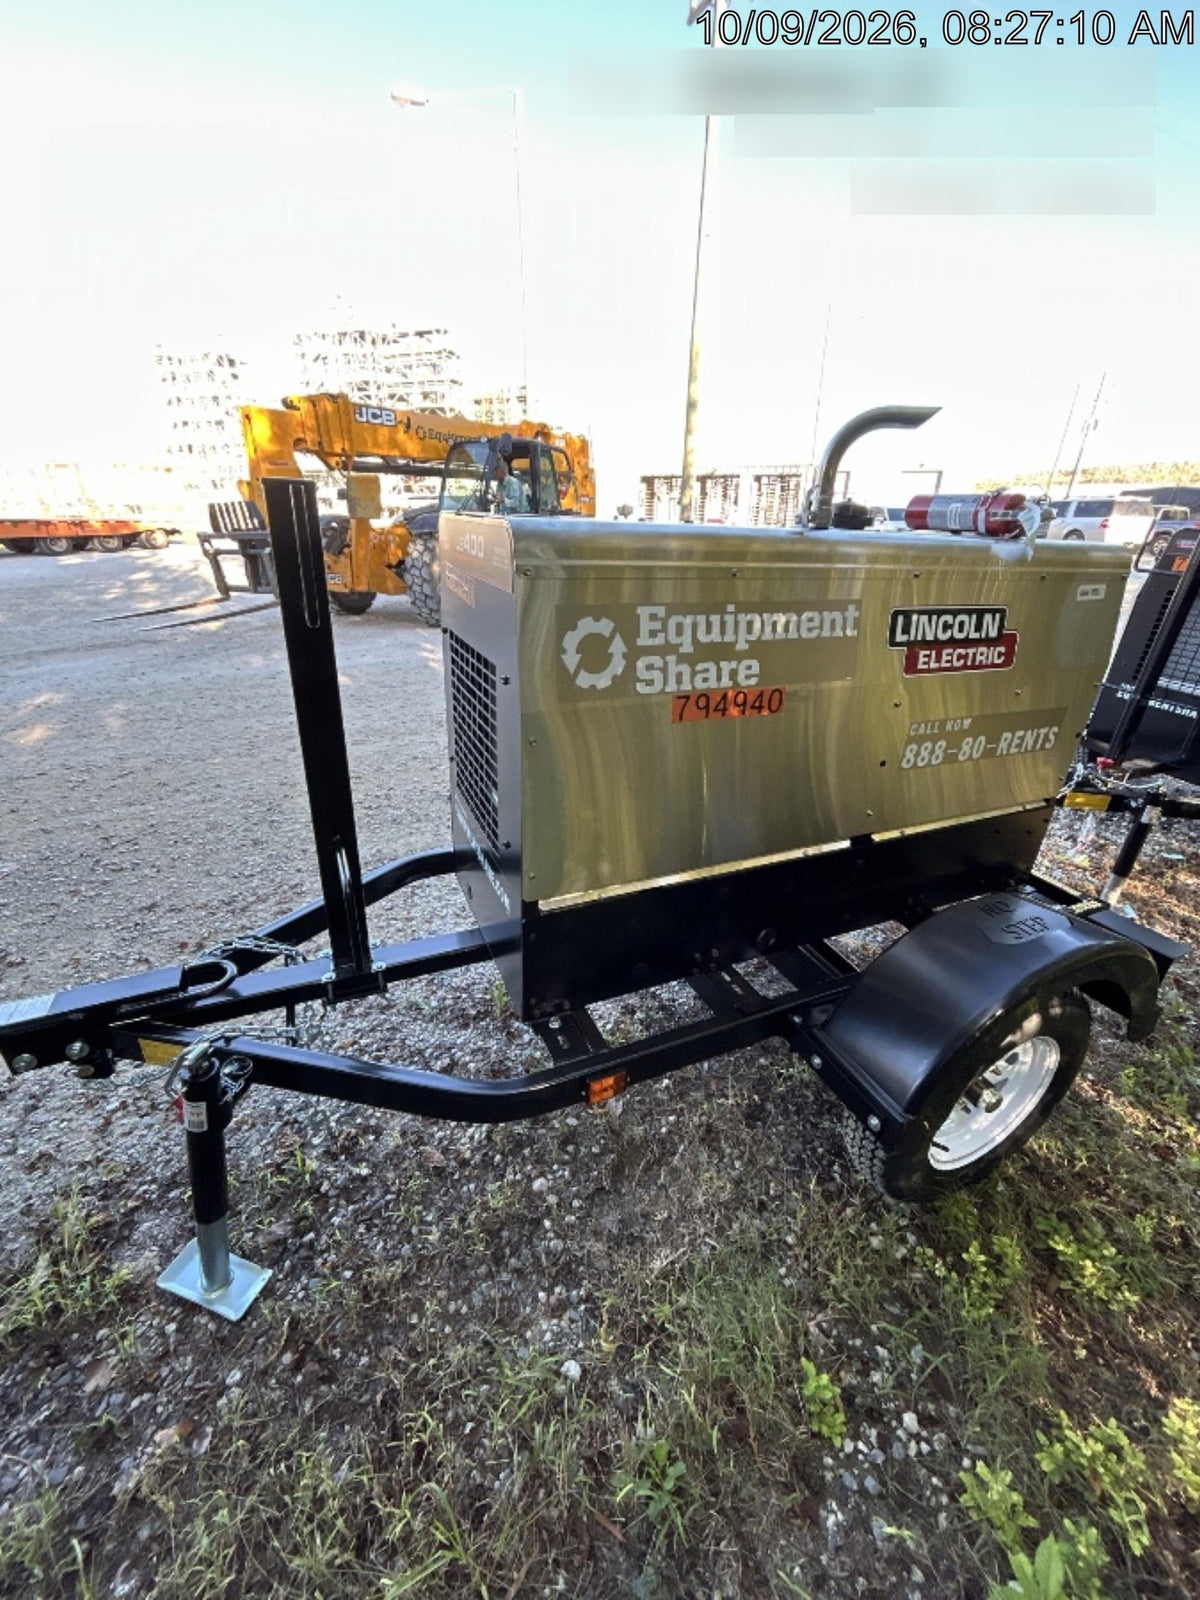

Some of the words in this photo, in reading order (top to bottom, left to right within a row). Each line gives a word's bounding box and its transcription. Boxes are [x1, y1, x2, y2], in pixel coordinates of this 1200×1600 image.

[355, 406, 396, 426] JCB
[636, 603, 860, 653] Equipment
[895, 612, 1001, 643] LINCOLN
[917, 646, 1006, 670] ELECTRIC
[636, 654, 760, 694] Share
[676, 688, 783, 722] 794940
[910, 721, 940, 736] CALL
[945, 718, 972, 732] NOW
[901, 726, 1059, 769] 888-80-RENTS
[977, 900, 1014, 918] NO
[1001, 916, 1050, 941] STEP
